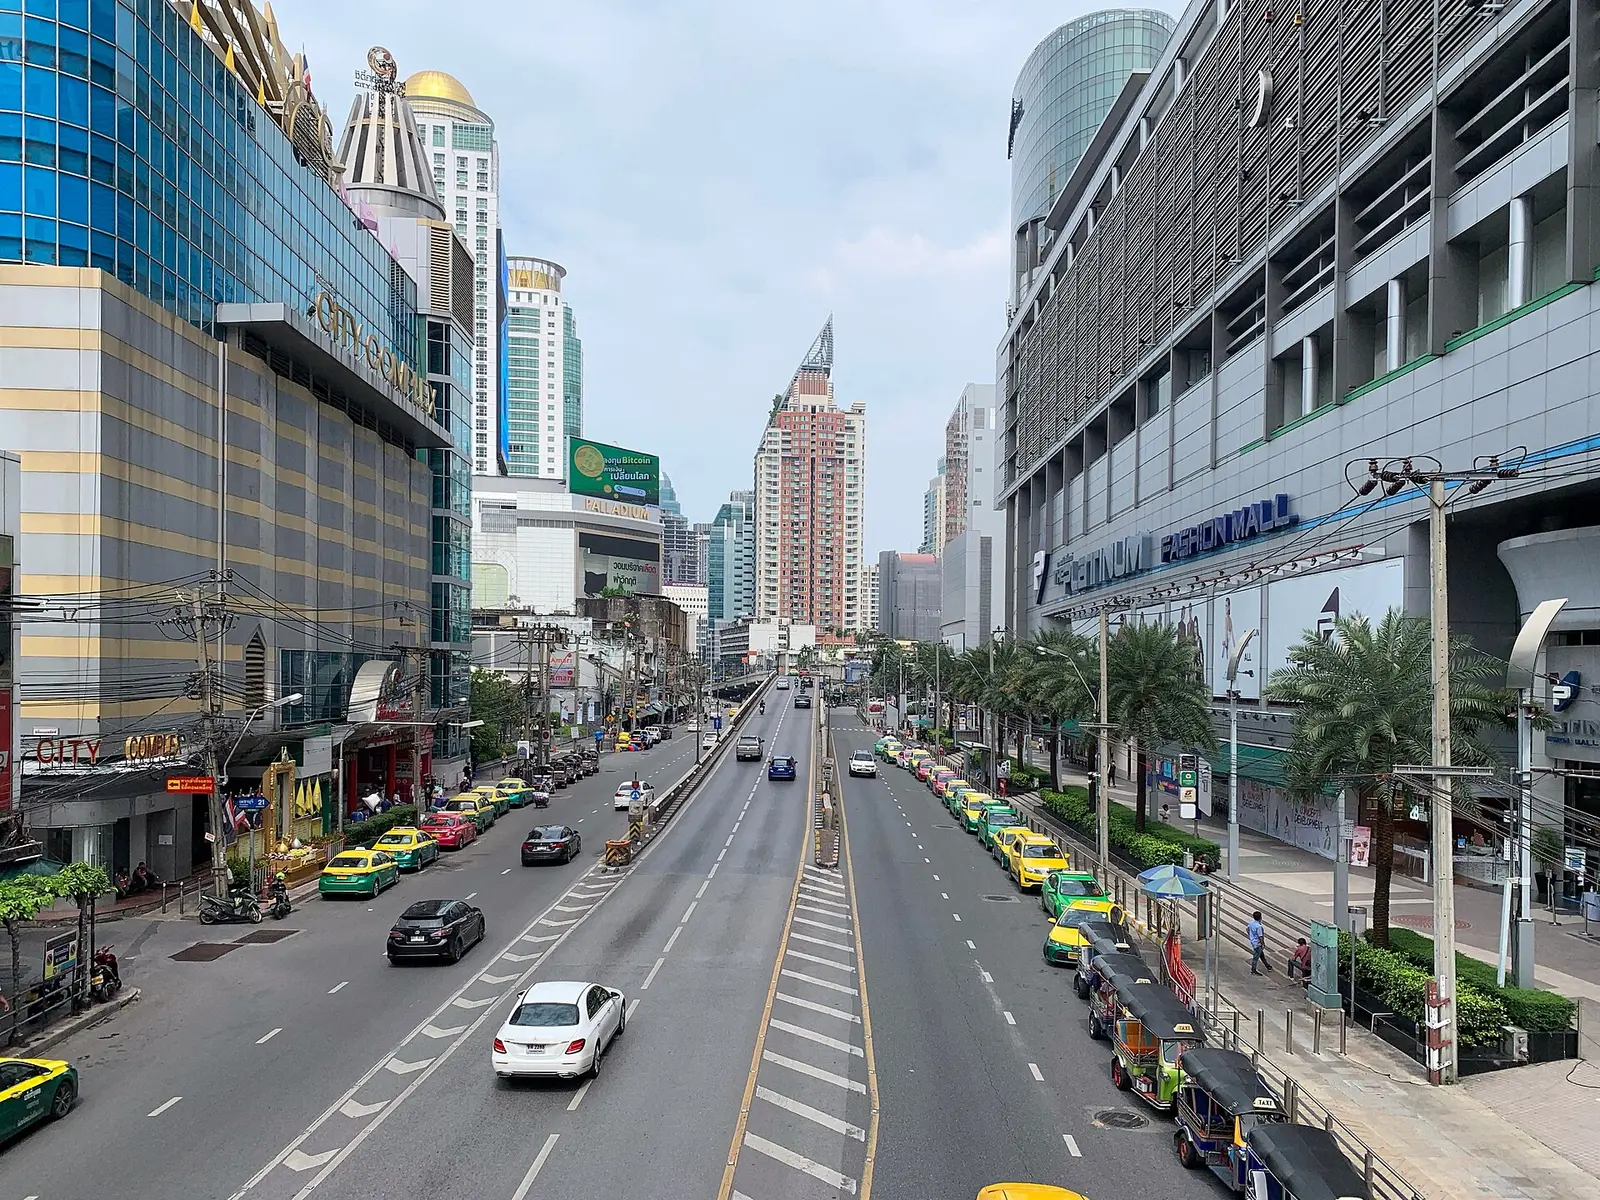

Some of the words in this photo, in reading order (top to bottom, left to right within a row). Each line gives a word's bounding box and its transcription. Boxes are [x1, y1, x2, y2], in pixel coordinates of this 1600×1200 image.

[316, 291, 362, 356] CITY
[584, 498, 649, 520] PALLADIUM
[1161, 514, 1233, 563] FASHION
[1231, 493, 1299, 541] MALL
[36, 740, 101, 764] CITY
